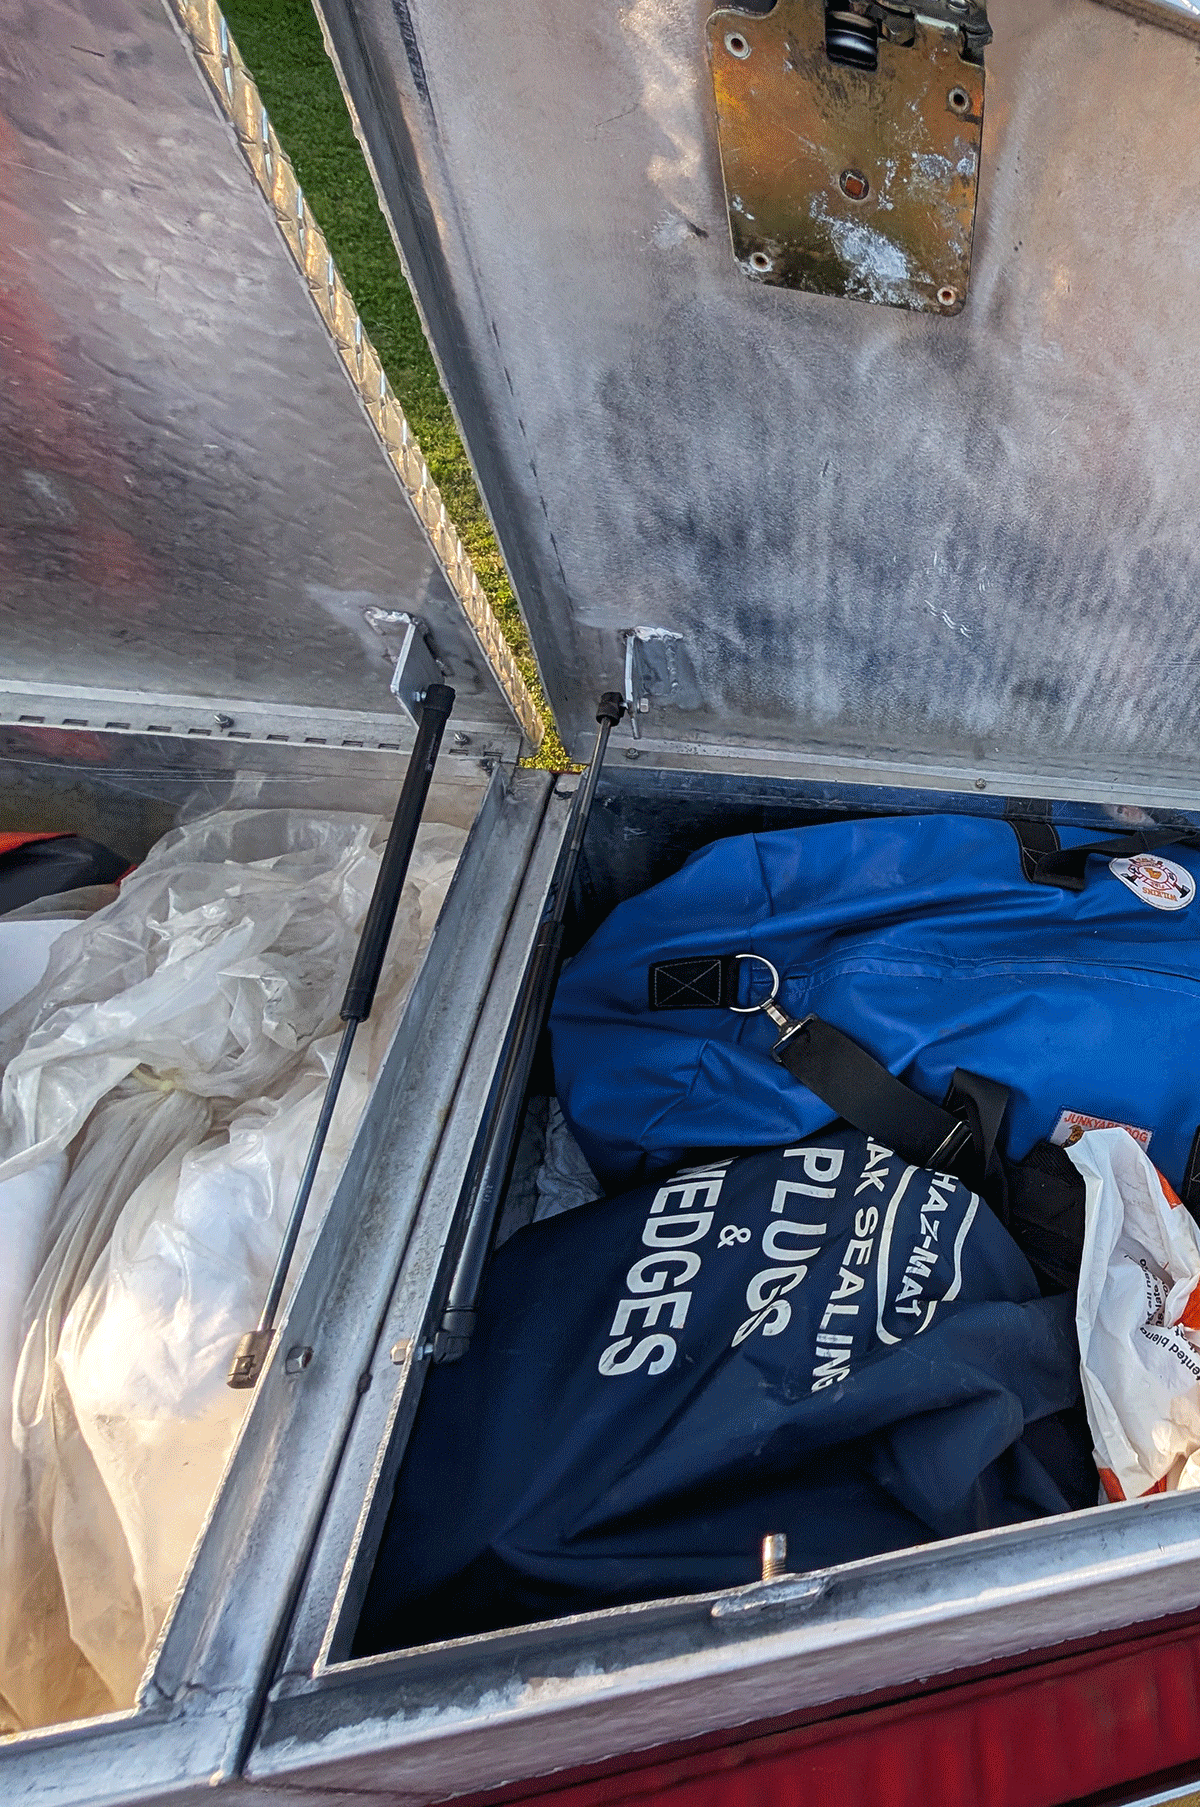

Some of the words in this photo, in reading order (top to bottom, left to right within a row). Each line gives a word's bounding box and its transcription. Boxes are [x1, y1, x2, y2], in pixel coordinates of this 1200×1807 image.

[1142, 886, 1178, 902] WILKINS
[717, 1224, 752, 1249] &
[853, 1136, 894, 1197] AK
[598, 1155, 740, 1377] WEDGES
[731, 1146, 846, 1349] PLUGS
[811, 1205, 879, 1394] SEALING
[895, 1169, 960, 1318] HAZ-MAT
